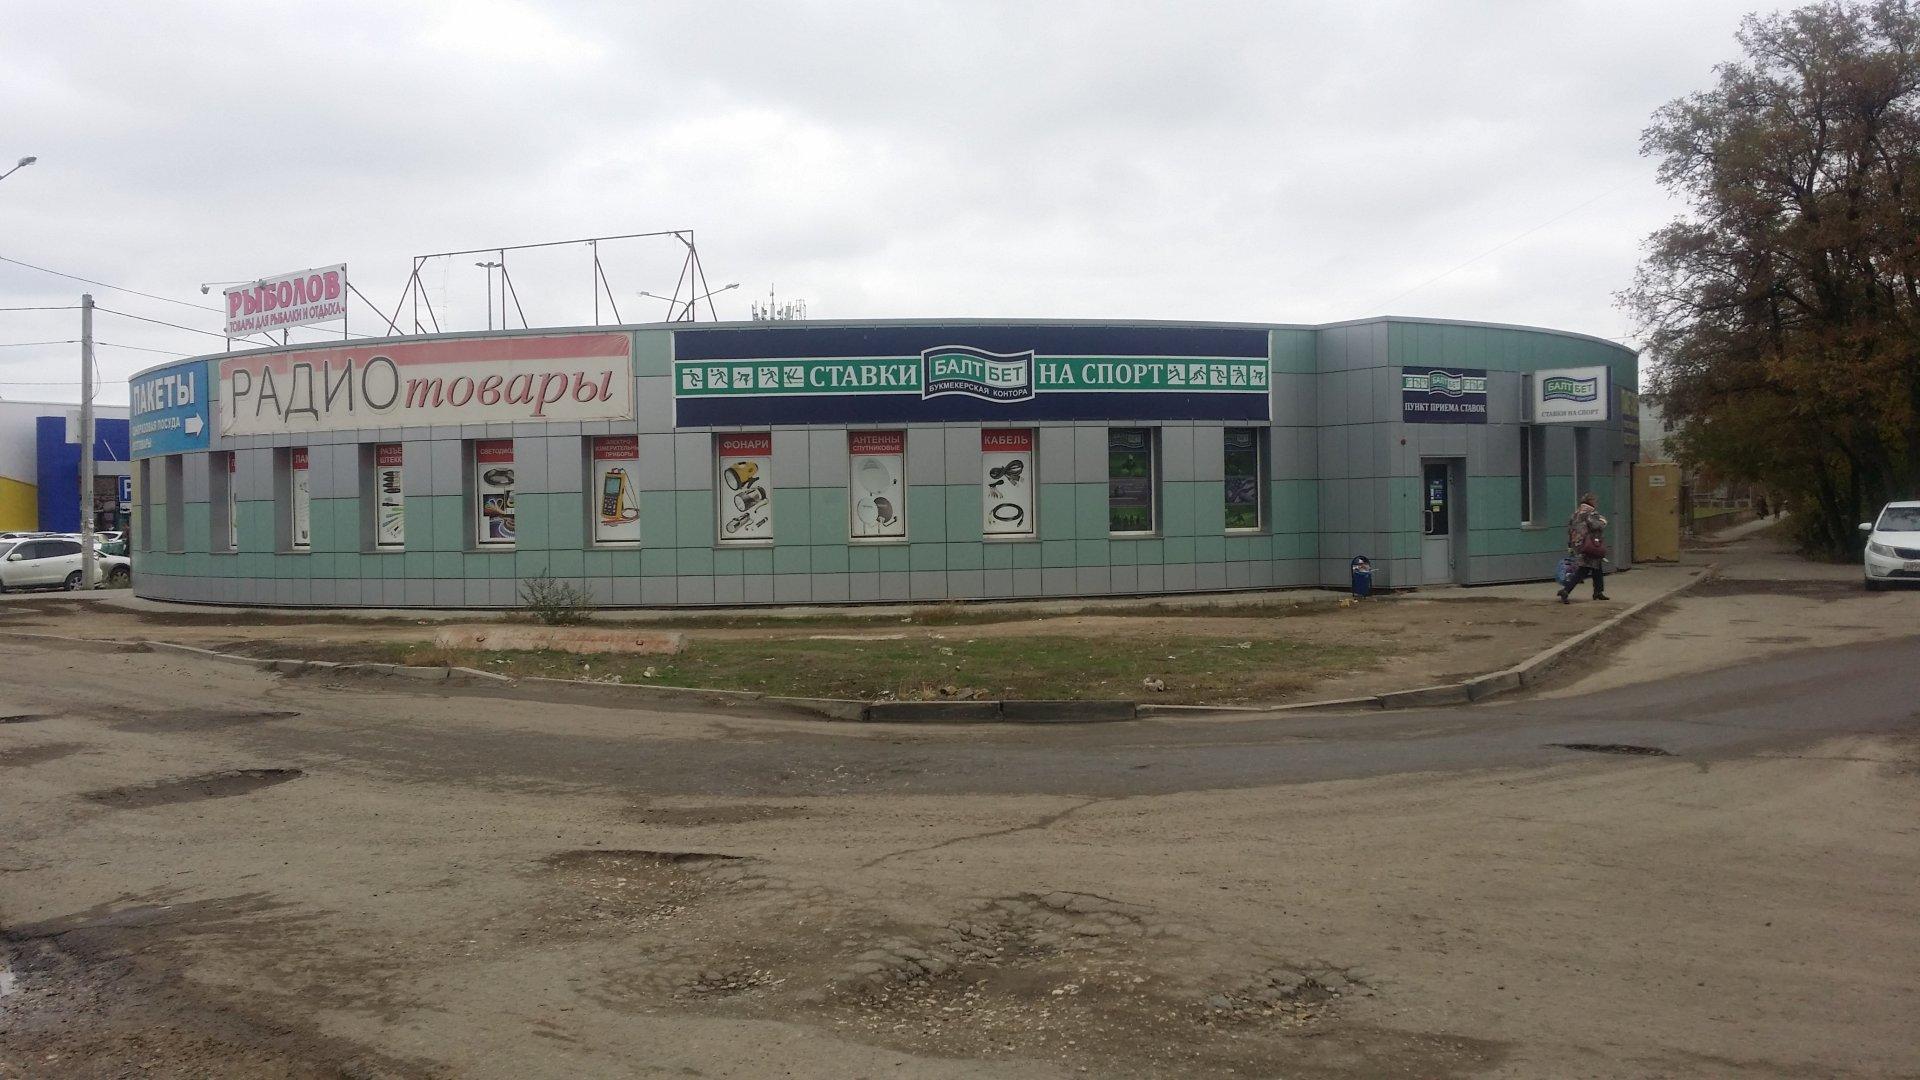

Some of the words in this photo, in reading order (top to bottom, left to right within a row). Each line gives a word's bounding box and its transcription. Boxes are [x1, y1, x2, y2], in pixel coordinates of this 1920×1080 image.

[228, 270, 341, 318] РЫБОЛОВ
[229, 317, 254, 333] ТОВАРЫ
[255, 314, 269, 330] ДЛЯ
[270, 309, 301, 325] РЫБАЛКИ
[302, 306, 308, 320] И
[309, 302, 341, 319] ОТДЫХА
[810, 364, 918, 387] СТАВКИ
[1039, 363, 1075, 385] НА
[1081, 363, 1164, 384] СПОРТ
[133, 371, 195, 416] ПАКЕТЫ
[929, 381, 990, 395] БУКМЕКЕРСКАЯ
[992, 388, 1028, 397] КОНТОРА
[1404, 402, 1429, 411] ПУНКТ
[1430, 403, 1459, 412] ПРИЕМА
[1460, 404, 1486, 413] СТАВОК
[157, 416, 181, 431] ПОСУДА
[722, 438, 769, 450] ФОНАРИ
[853, 435, 900, 444] АНТЕННЫ
[984, 435, 1028, 445] КАБЕЛЬ
